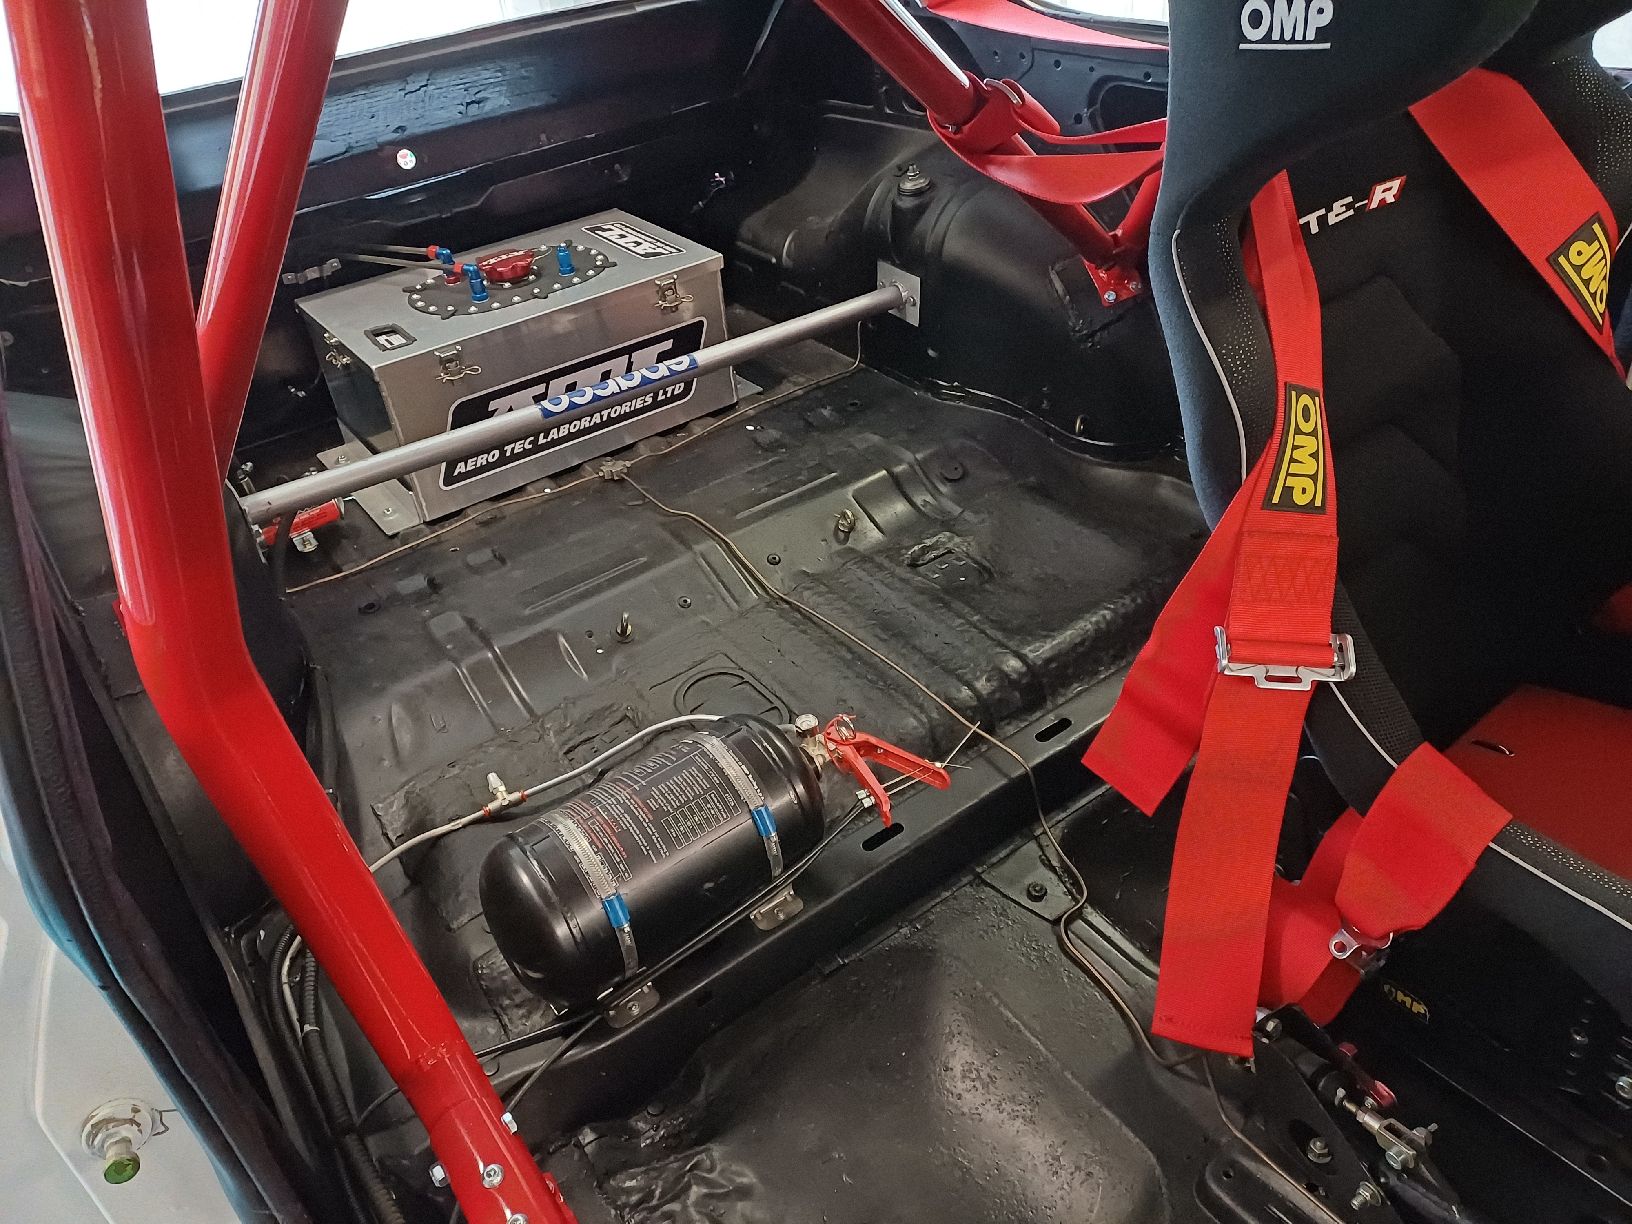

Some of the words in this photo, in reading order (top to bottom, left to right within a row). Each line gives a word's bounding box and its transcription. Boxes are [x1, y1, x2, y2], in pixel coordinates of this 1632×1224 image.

[1241, 0, 1334, 41] OMP
[1568, 239, 1607, 313] OMP
[453, 450, 499, 476] AERO
[504, 437, 533, 456] TEC
[538, 393, 654, 444] LABORATORIES
[657, 382, 685, 401] LTD
[1285, 393, 1318, 506] OMP
[1384, 985, 1426, 1014] OMP
